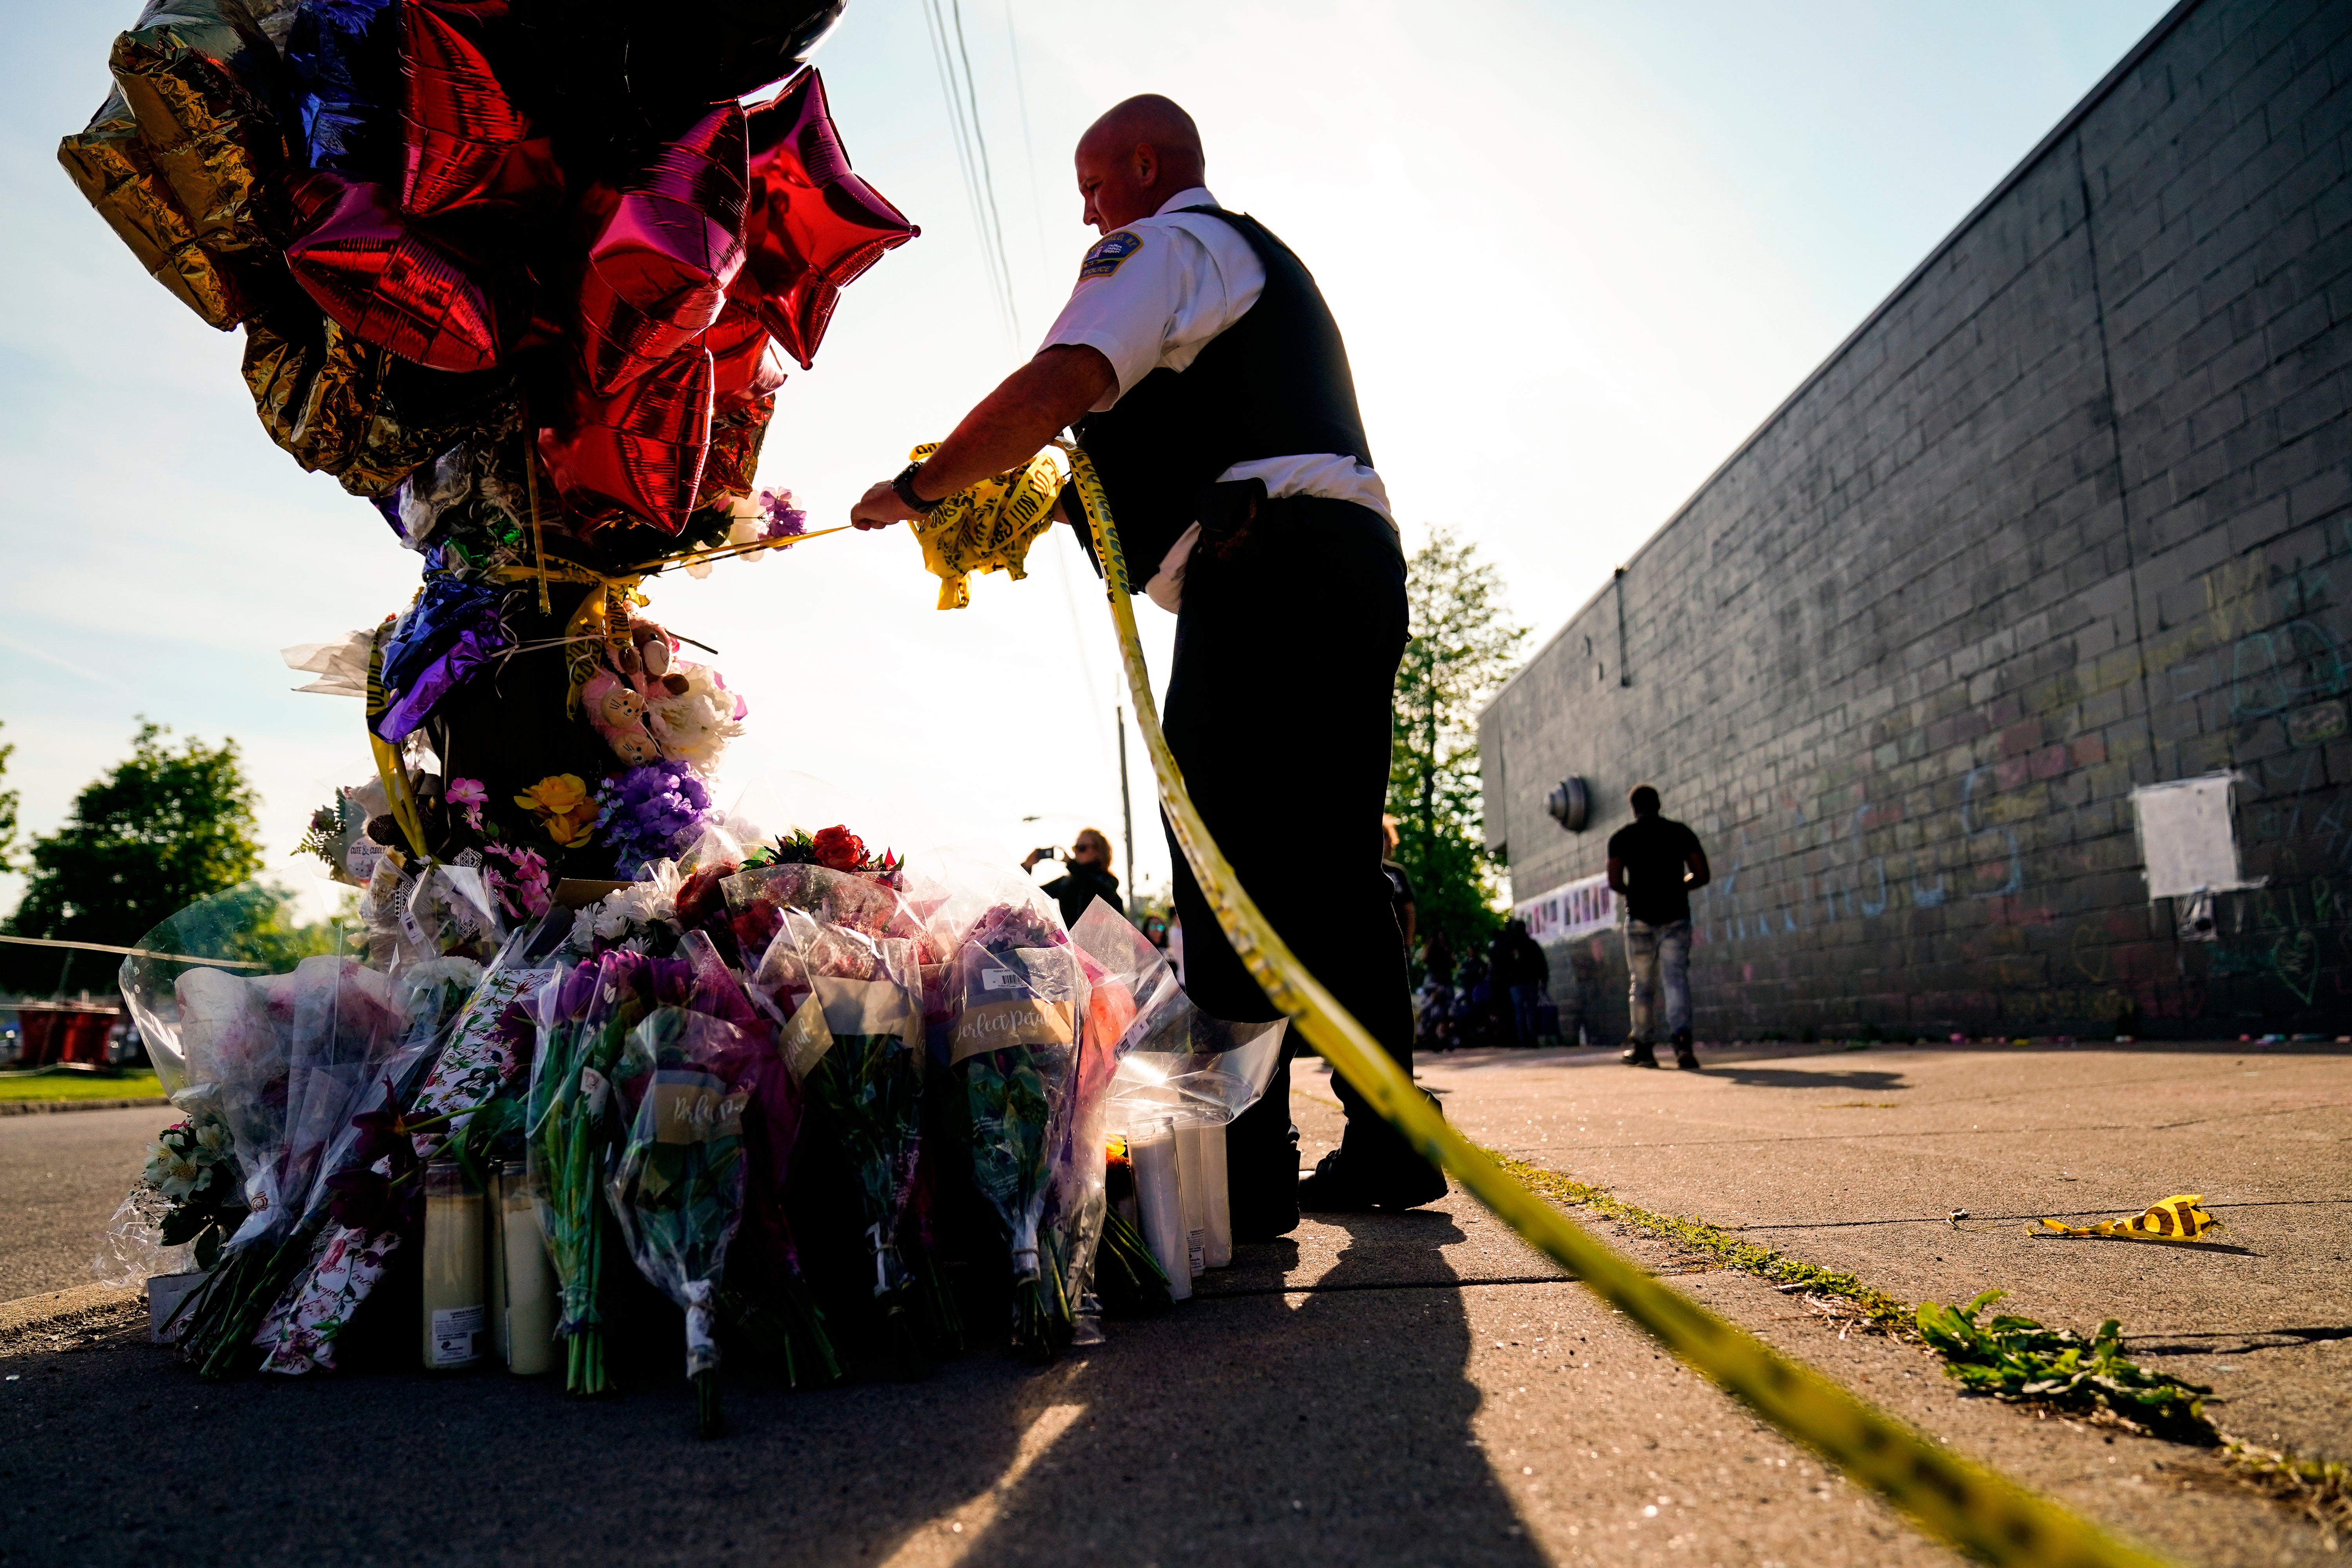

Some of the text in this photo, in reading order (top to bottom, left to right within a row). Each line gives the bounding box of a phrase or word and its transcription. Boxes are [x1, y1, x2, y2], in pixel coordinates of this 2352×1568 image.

[1083, 266, 1111, 276] POLICE
[362, 845, 370, 856] &
[1009, 1005, 1054, 1032] Petal
